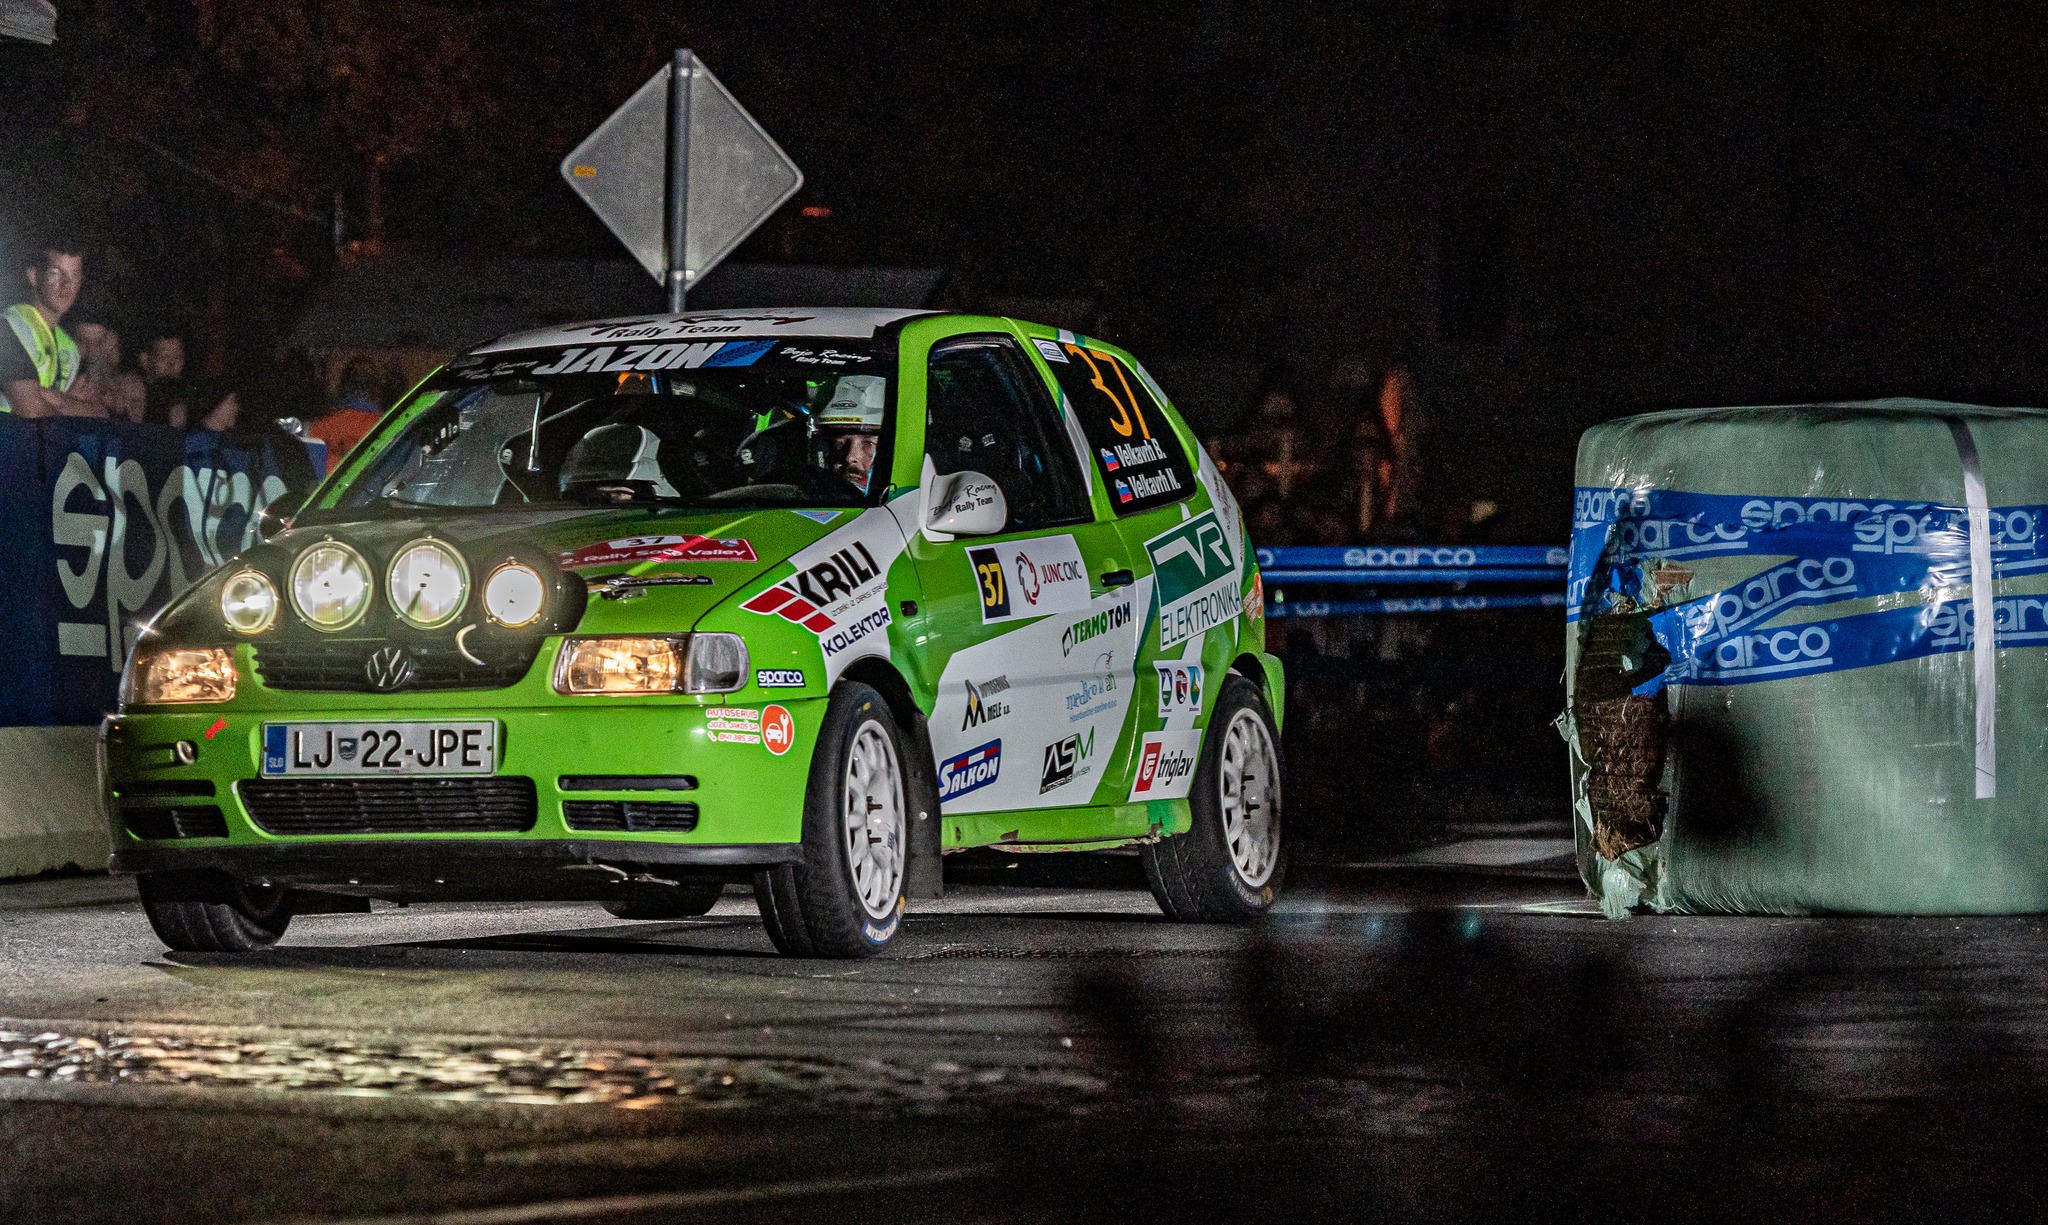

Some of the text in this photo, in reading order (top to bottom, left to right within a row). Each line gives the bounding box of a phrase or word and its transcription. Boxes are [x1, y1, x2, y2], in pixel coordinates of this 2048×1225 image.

[607, 326, 669, 339] Rally
[675, 324, 741, 334] Team
[531, 341, 728, 375] JAZON
[1064, 343, 1151, 440] 37
[1114, 438, 1168, 467] Velkavrh B.
[1128, 467, 1182, 498] Velkavrh N.
[955, 497, 994, 513] Rally Team
[584, 552, 631, 562] Rally
[626, 536, 666, 546] 37
[1344, 548, 1476, 567] sparco
[780, 540, 882, 608] KRILI
[978, 562, 1004, 607] 37
[1162, 580, 1243, 646] ELEKTRONIKA
[1686, 557, 1855, 638] sparco
[822, 606, 891, 657] KOLEKTOR
[1073, 601, 1131, 645] TERMOTOM
[758, 671, 803, 687] sparco
[707, 709, 758, 719] AUTOSERVIS
[268, 757, 284, 768] SLO
[293, 729, 483, 768] LJ 22-JPE
[940, 756, 999, 797] SALKON
[1157, 750, 1194, 786] triglav
